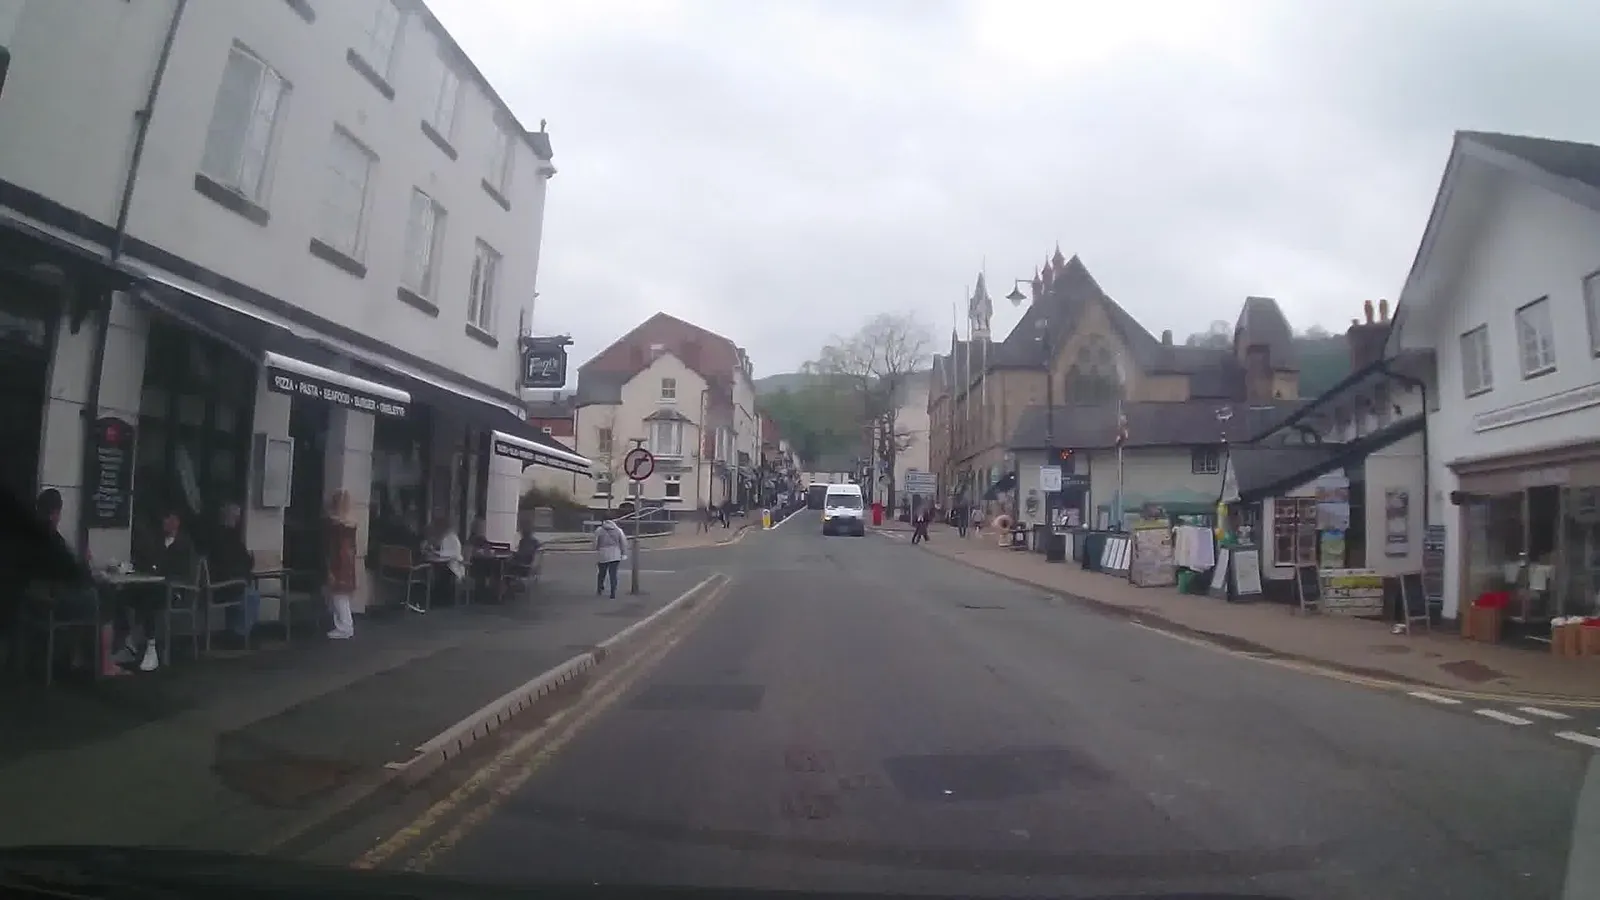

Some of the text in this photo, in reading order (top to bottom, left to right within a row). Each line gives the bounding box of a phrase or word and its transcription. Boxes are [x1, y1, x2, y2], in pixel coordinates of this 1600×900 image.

[275, 376, 294, 390] PIZZA
[299, 382, 319, 397] PASTA
[323, 388, 350, 404] SEAFOOD
